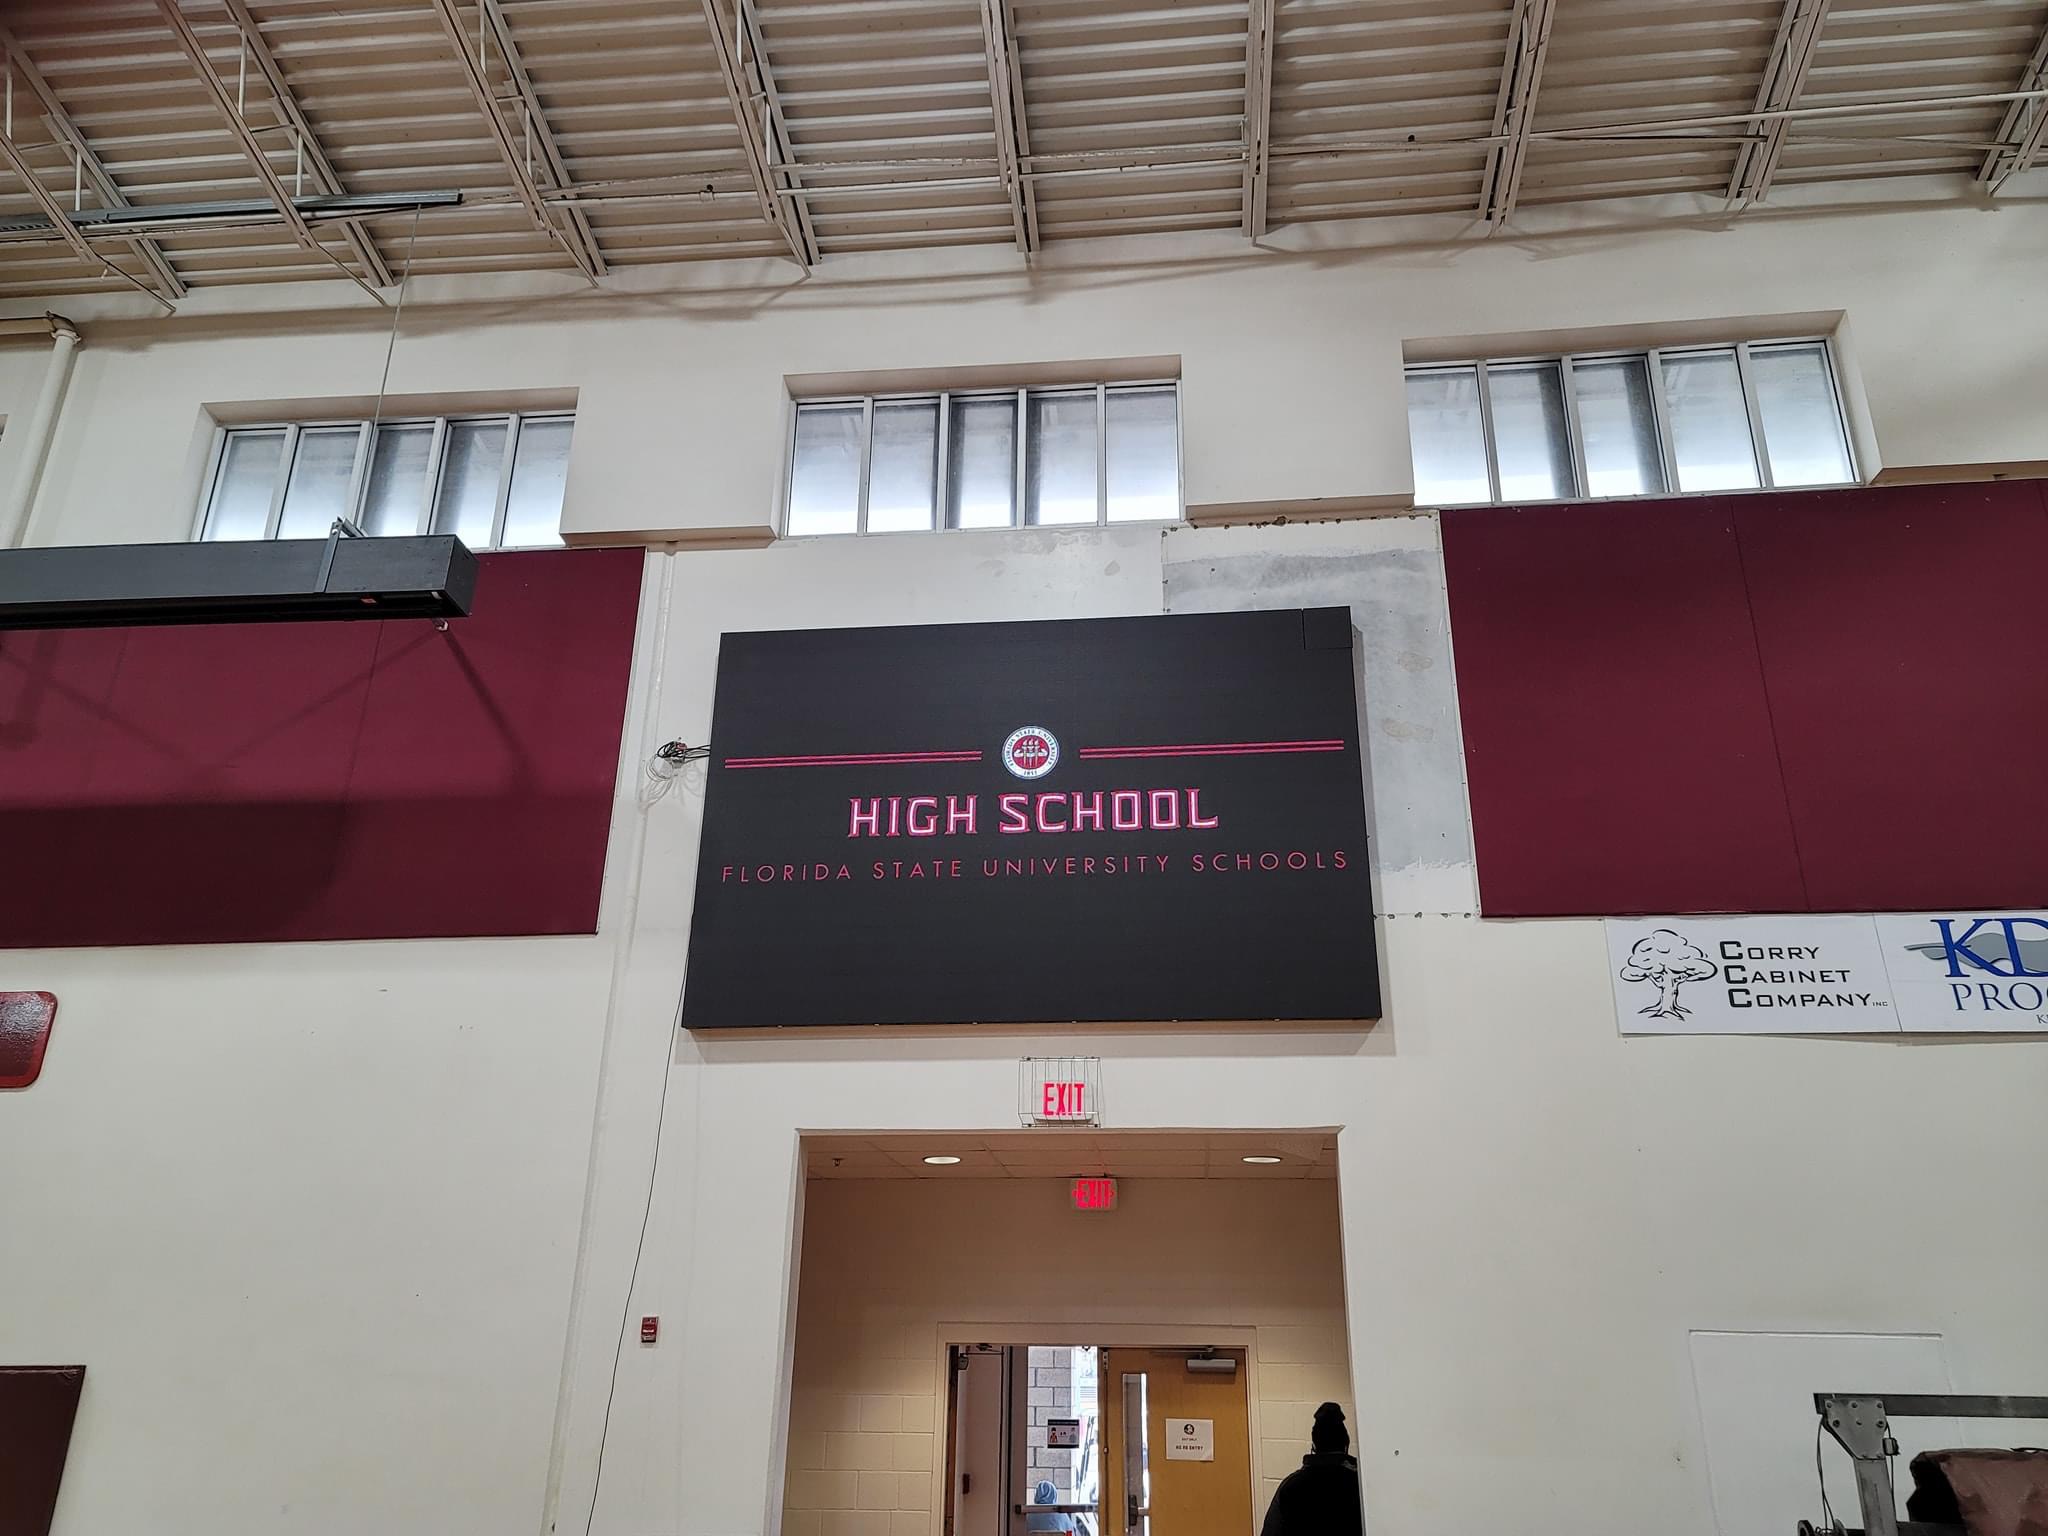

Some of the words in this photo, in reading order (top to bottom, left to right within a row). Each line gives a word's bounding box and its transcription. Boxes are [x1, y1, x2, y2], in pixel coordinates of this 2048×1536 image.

[848, 793, 978, 838] HIGH
[998, 788, 1220, 835] SCHOOL
[721, 864, 851, 883] FLORIDA
[872, 859, 962, 880] STATE
[983, 854, 1169, 878] UNIVERSITY
[1192, 850, 1347, 873] SCHOOLS
[1719, 940, 1820, 960] CORRY
[1723, 965, 1851, 984] CABINET
[1728, 988, 1871, 1008] COMPANY
[1948, 982, 2048, 1011] PRO
[1043, 1081, 1086, 1116] EXIT
[1076, 1179, 1112, 1209] EXIT
